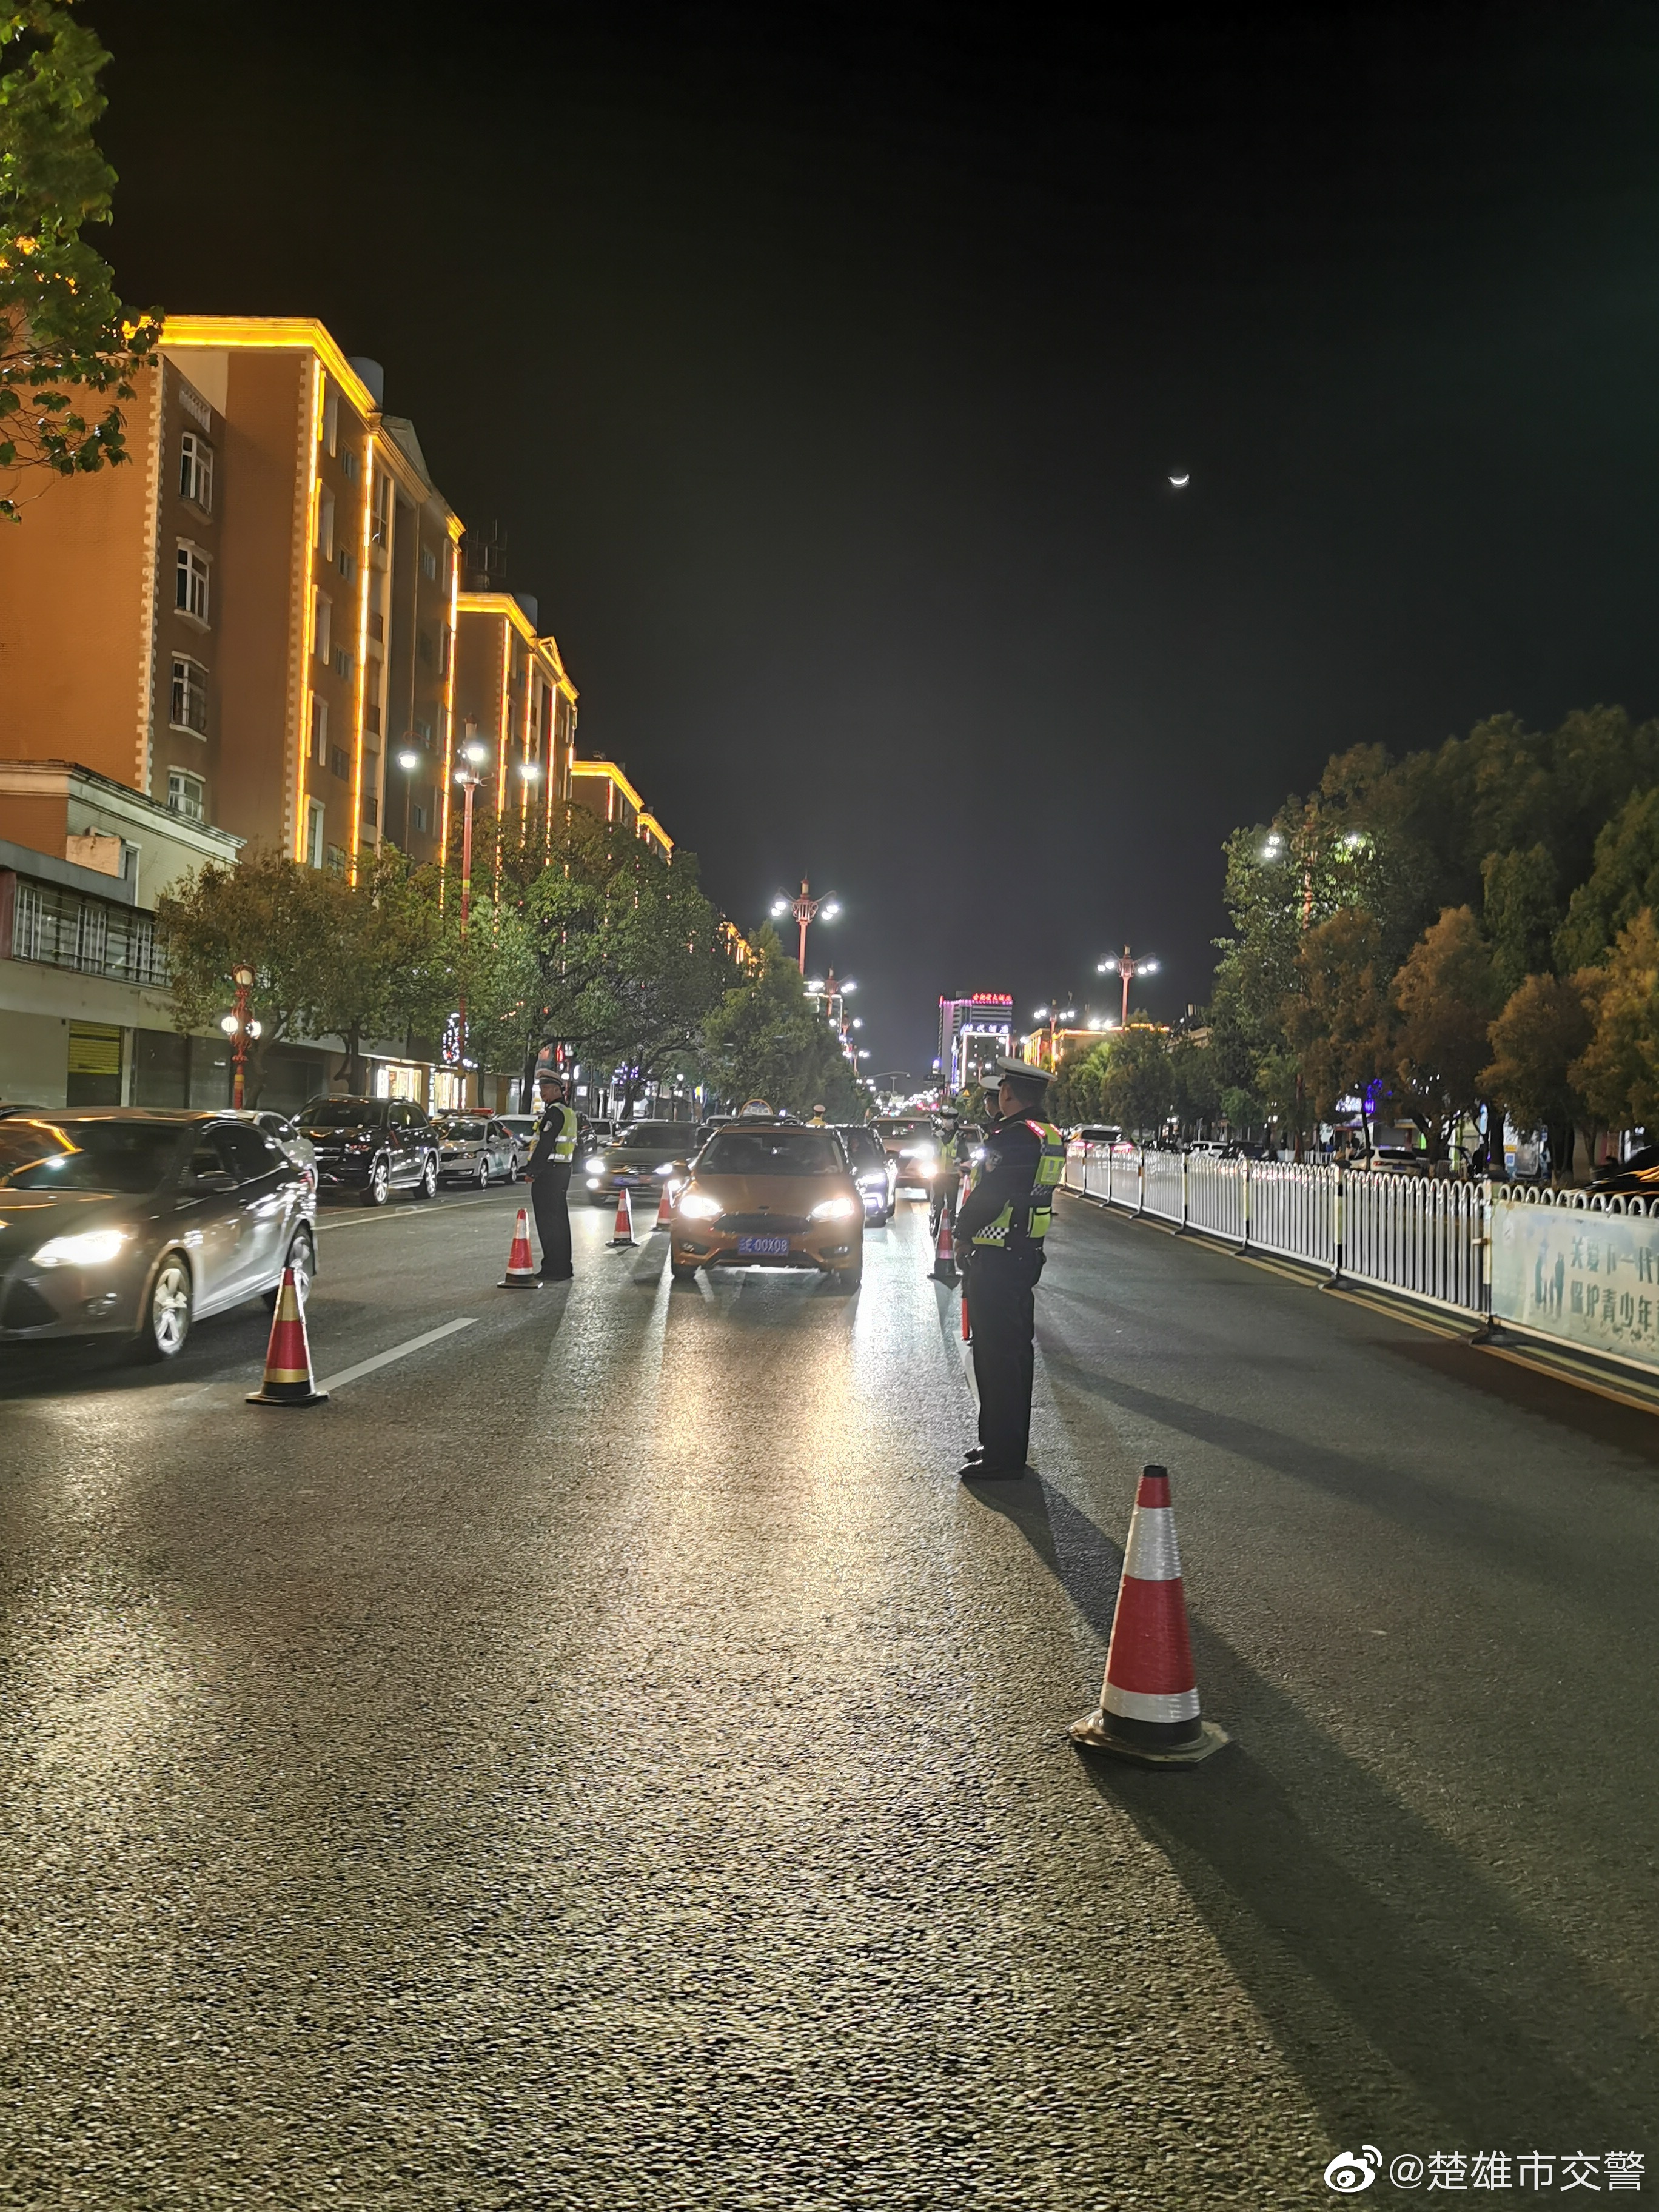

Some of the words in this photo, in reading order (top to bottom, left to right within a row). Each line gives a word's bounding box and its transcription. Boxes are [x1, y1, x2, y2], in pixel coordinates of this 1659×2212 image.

[1570, 1235, 1659, 1285] 关爱下一代
